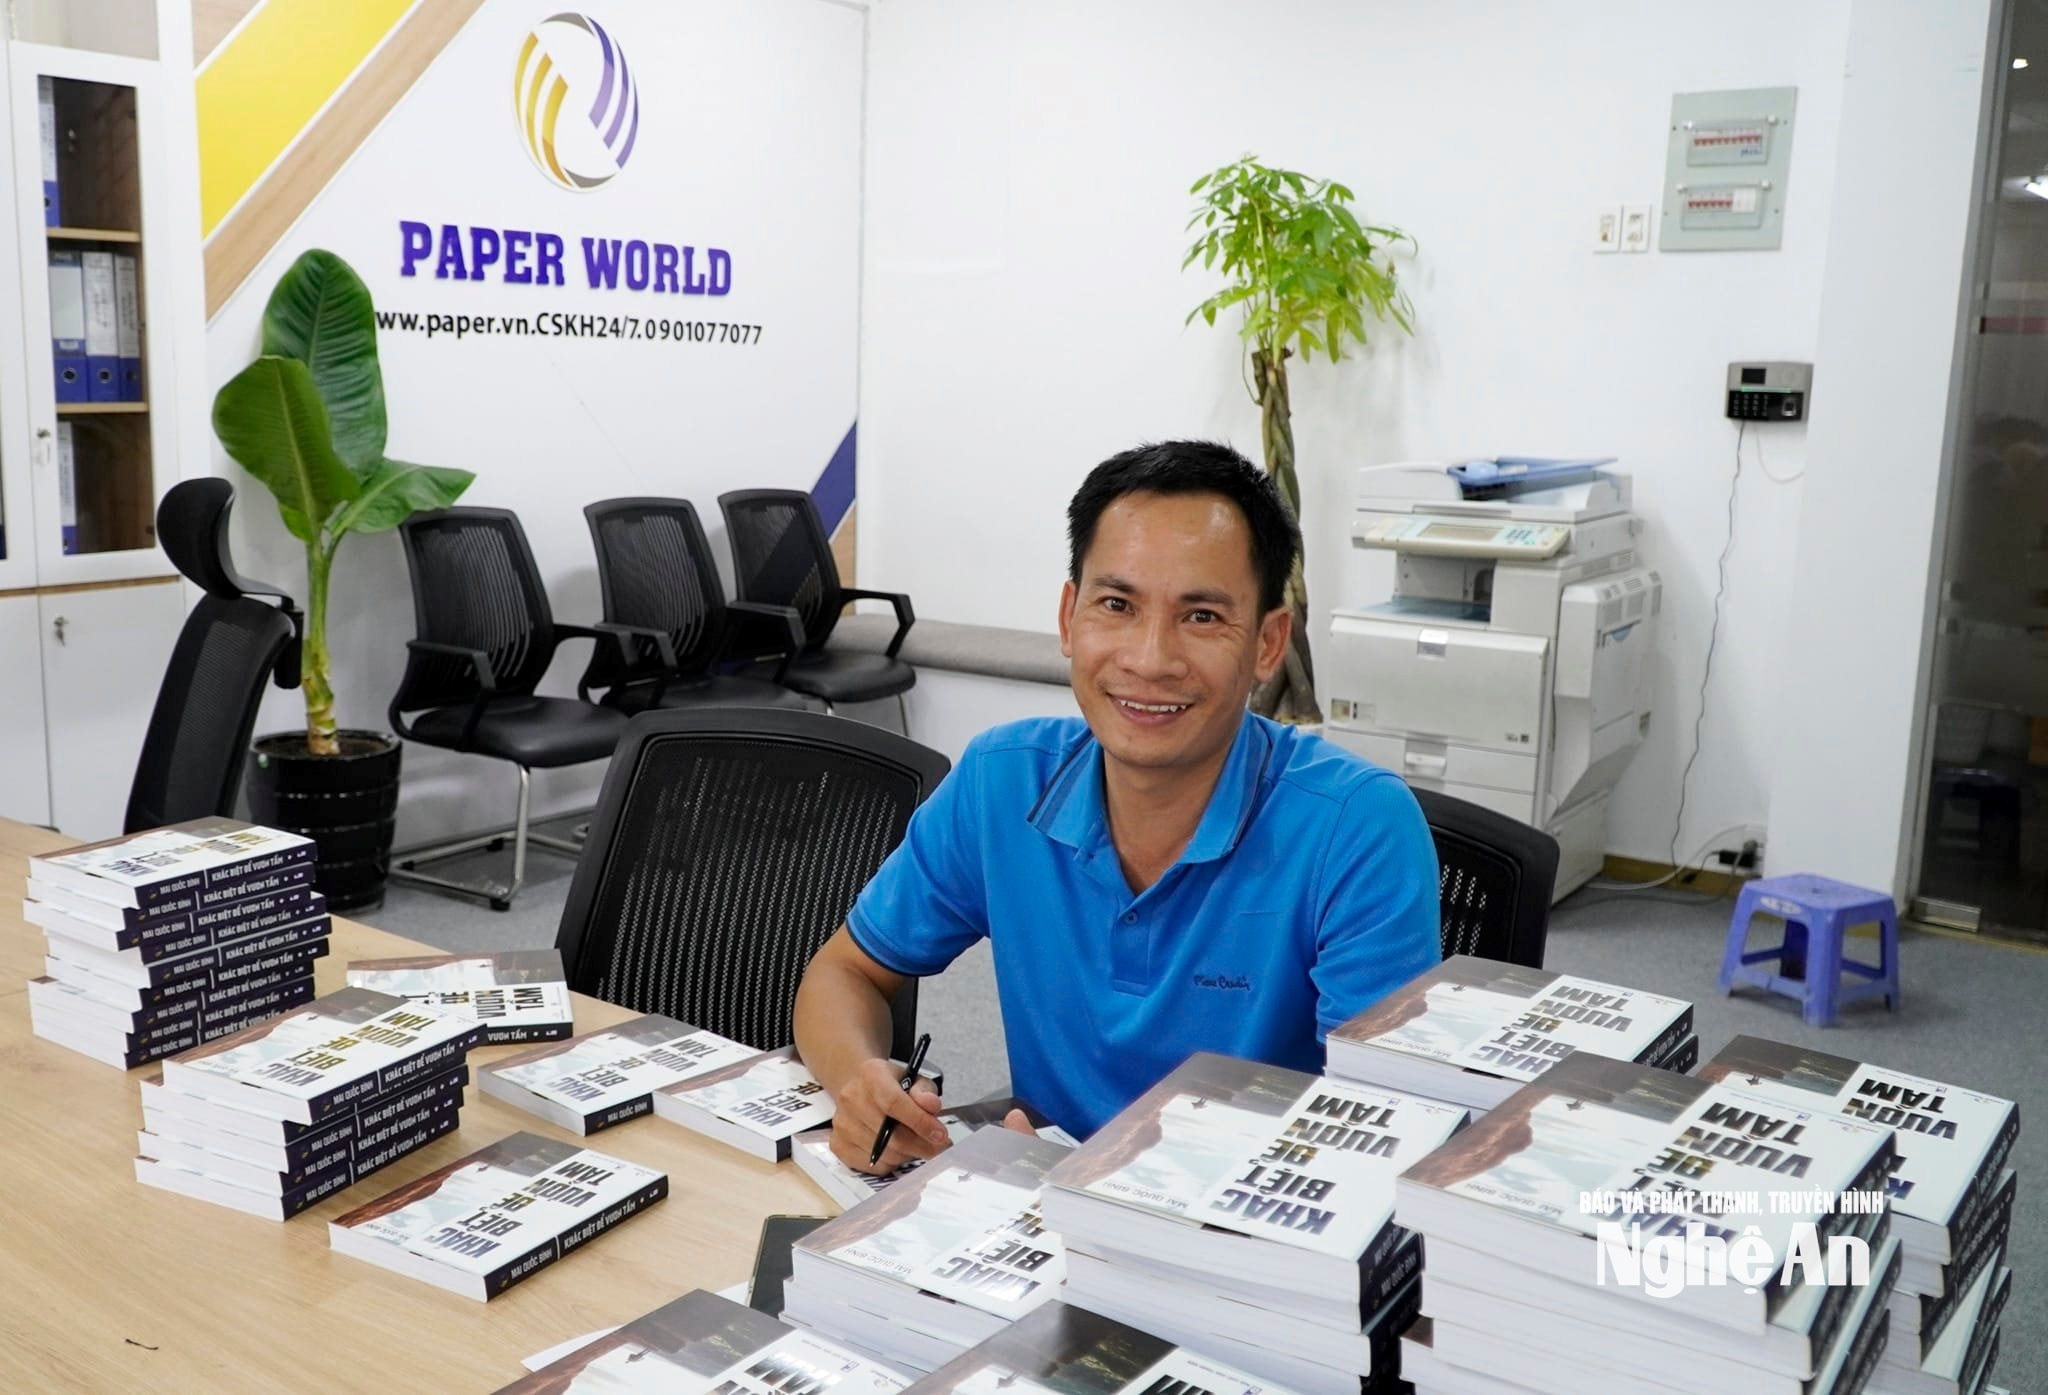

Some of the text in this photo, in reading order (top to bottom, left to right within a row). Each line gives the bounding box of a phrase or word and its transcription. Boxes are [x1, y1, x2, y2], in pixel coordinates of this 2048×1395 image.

[399, 220, 732, 296] PAPER WORLD
[375, 312, 762, 344] ww.paper.vn.CSKH24/7.0901077077
